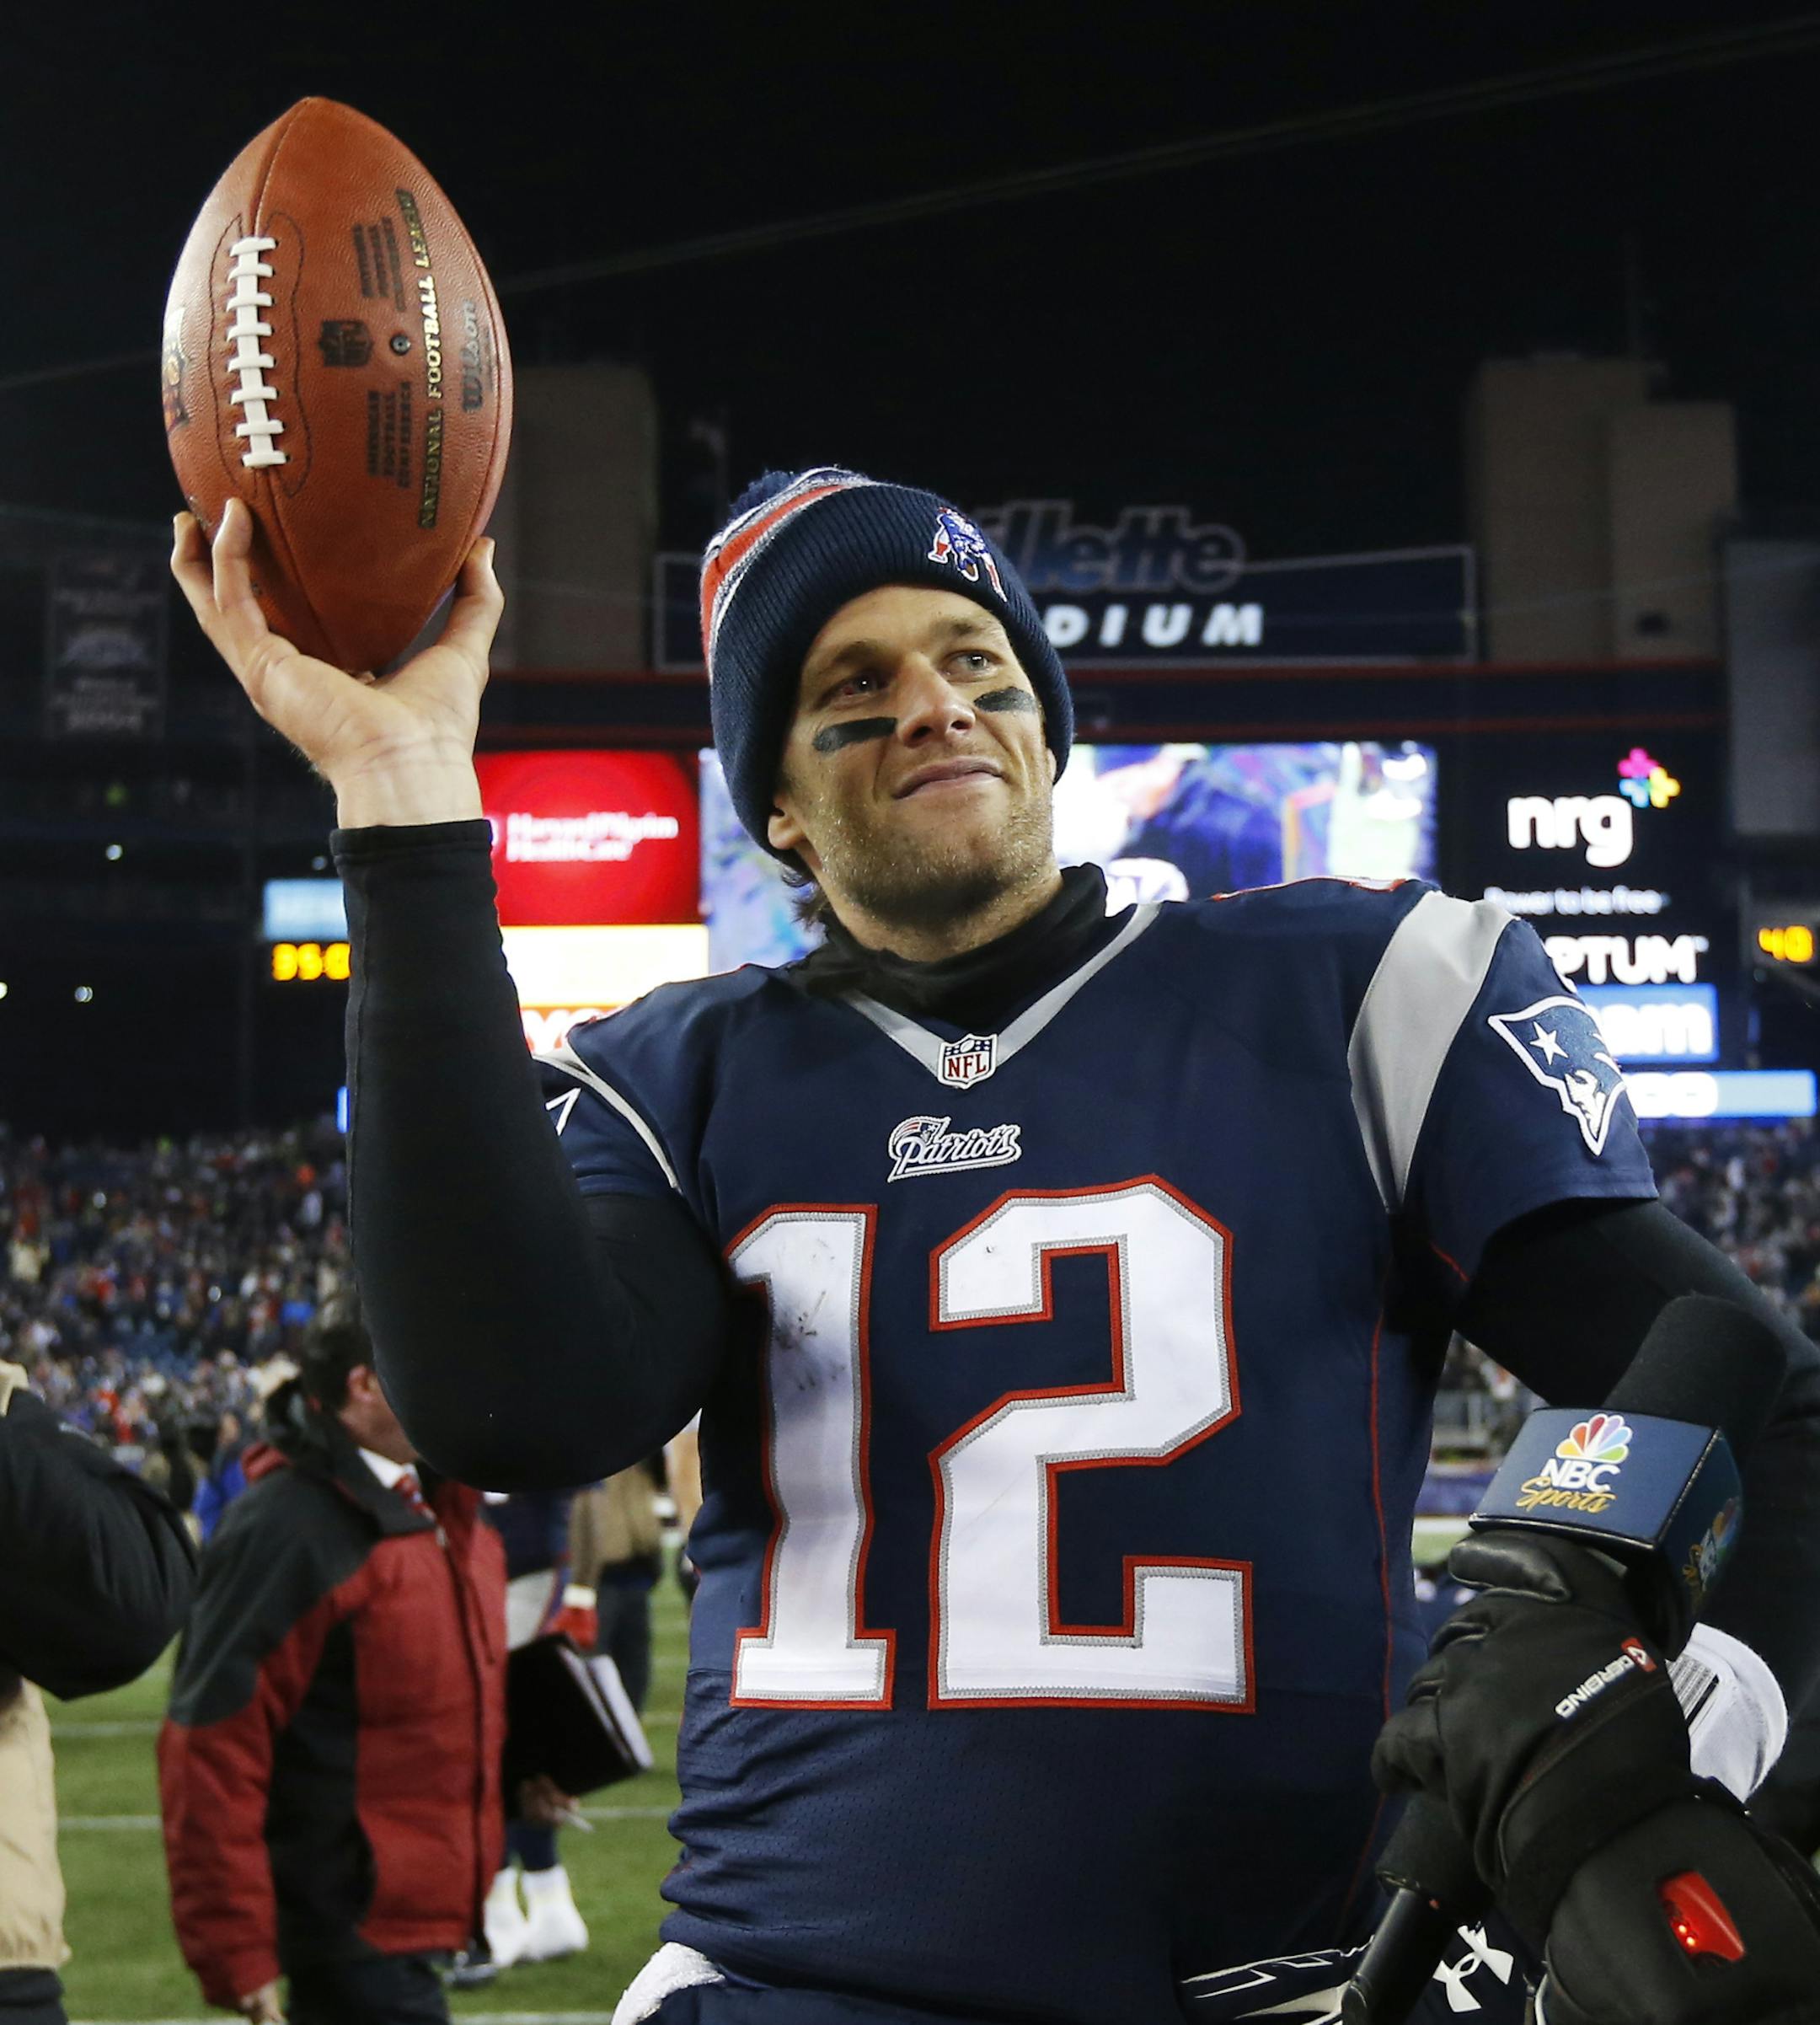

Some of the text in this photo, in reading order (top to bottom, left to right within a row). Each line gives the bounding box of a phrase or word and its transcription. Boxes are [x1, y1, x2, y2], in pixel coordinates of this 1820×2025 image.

[418, 275, 443, 399] FOOTBALL
[1043, 603, 1264, 648] DIUM
[1507, 795, 1634, 868] nrg
[947, 1053, 987, 1079] NFL
[887, 1116, 1022, 1183] Patriots
[724, 1173, 1255, 1714] 12
[1516, 1476, 1618, 1513] Sports
[1539, 1459, 1621, 1492] NBC
